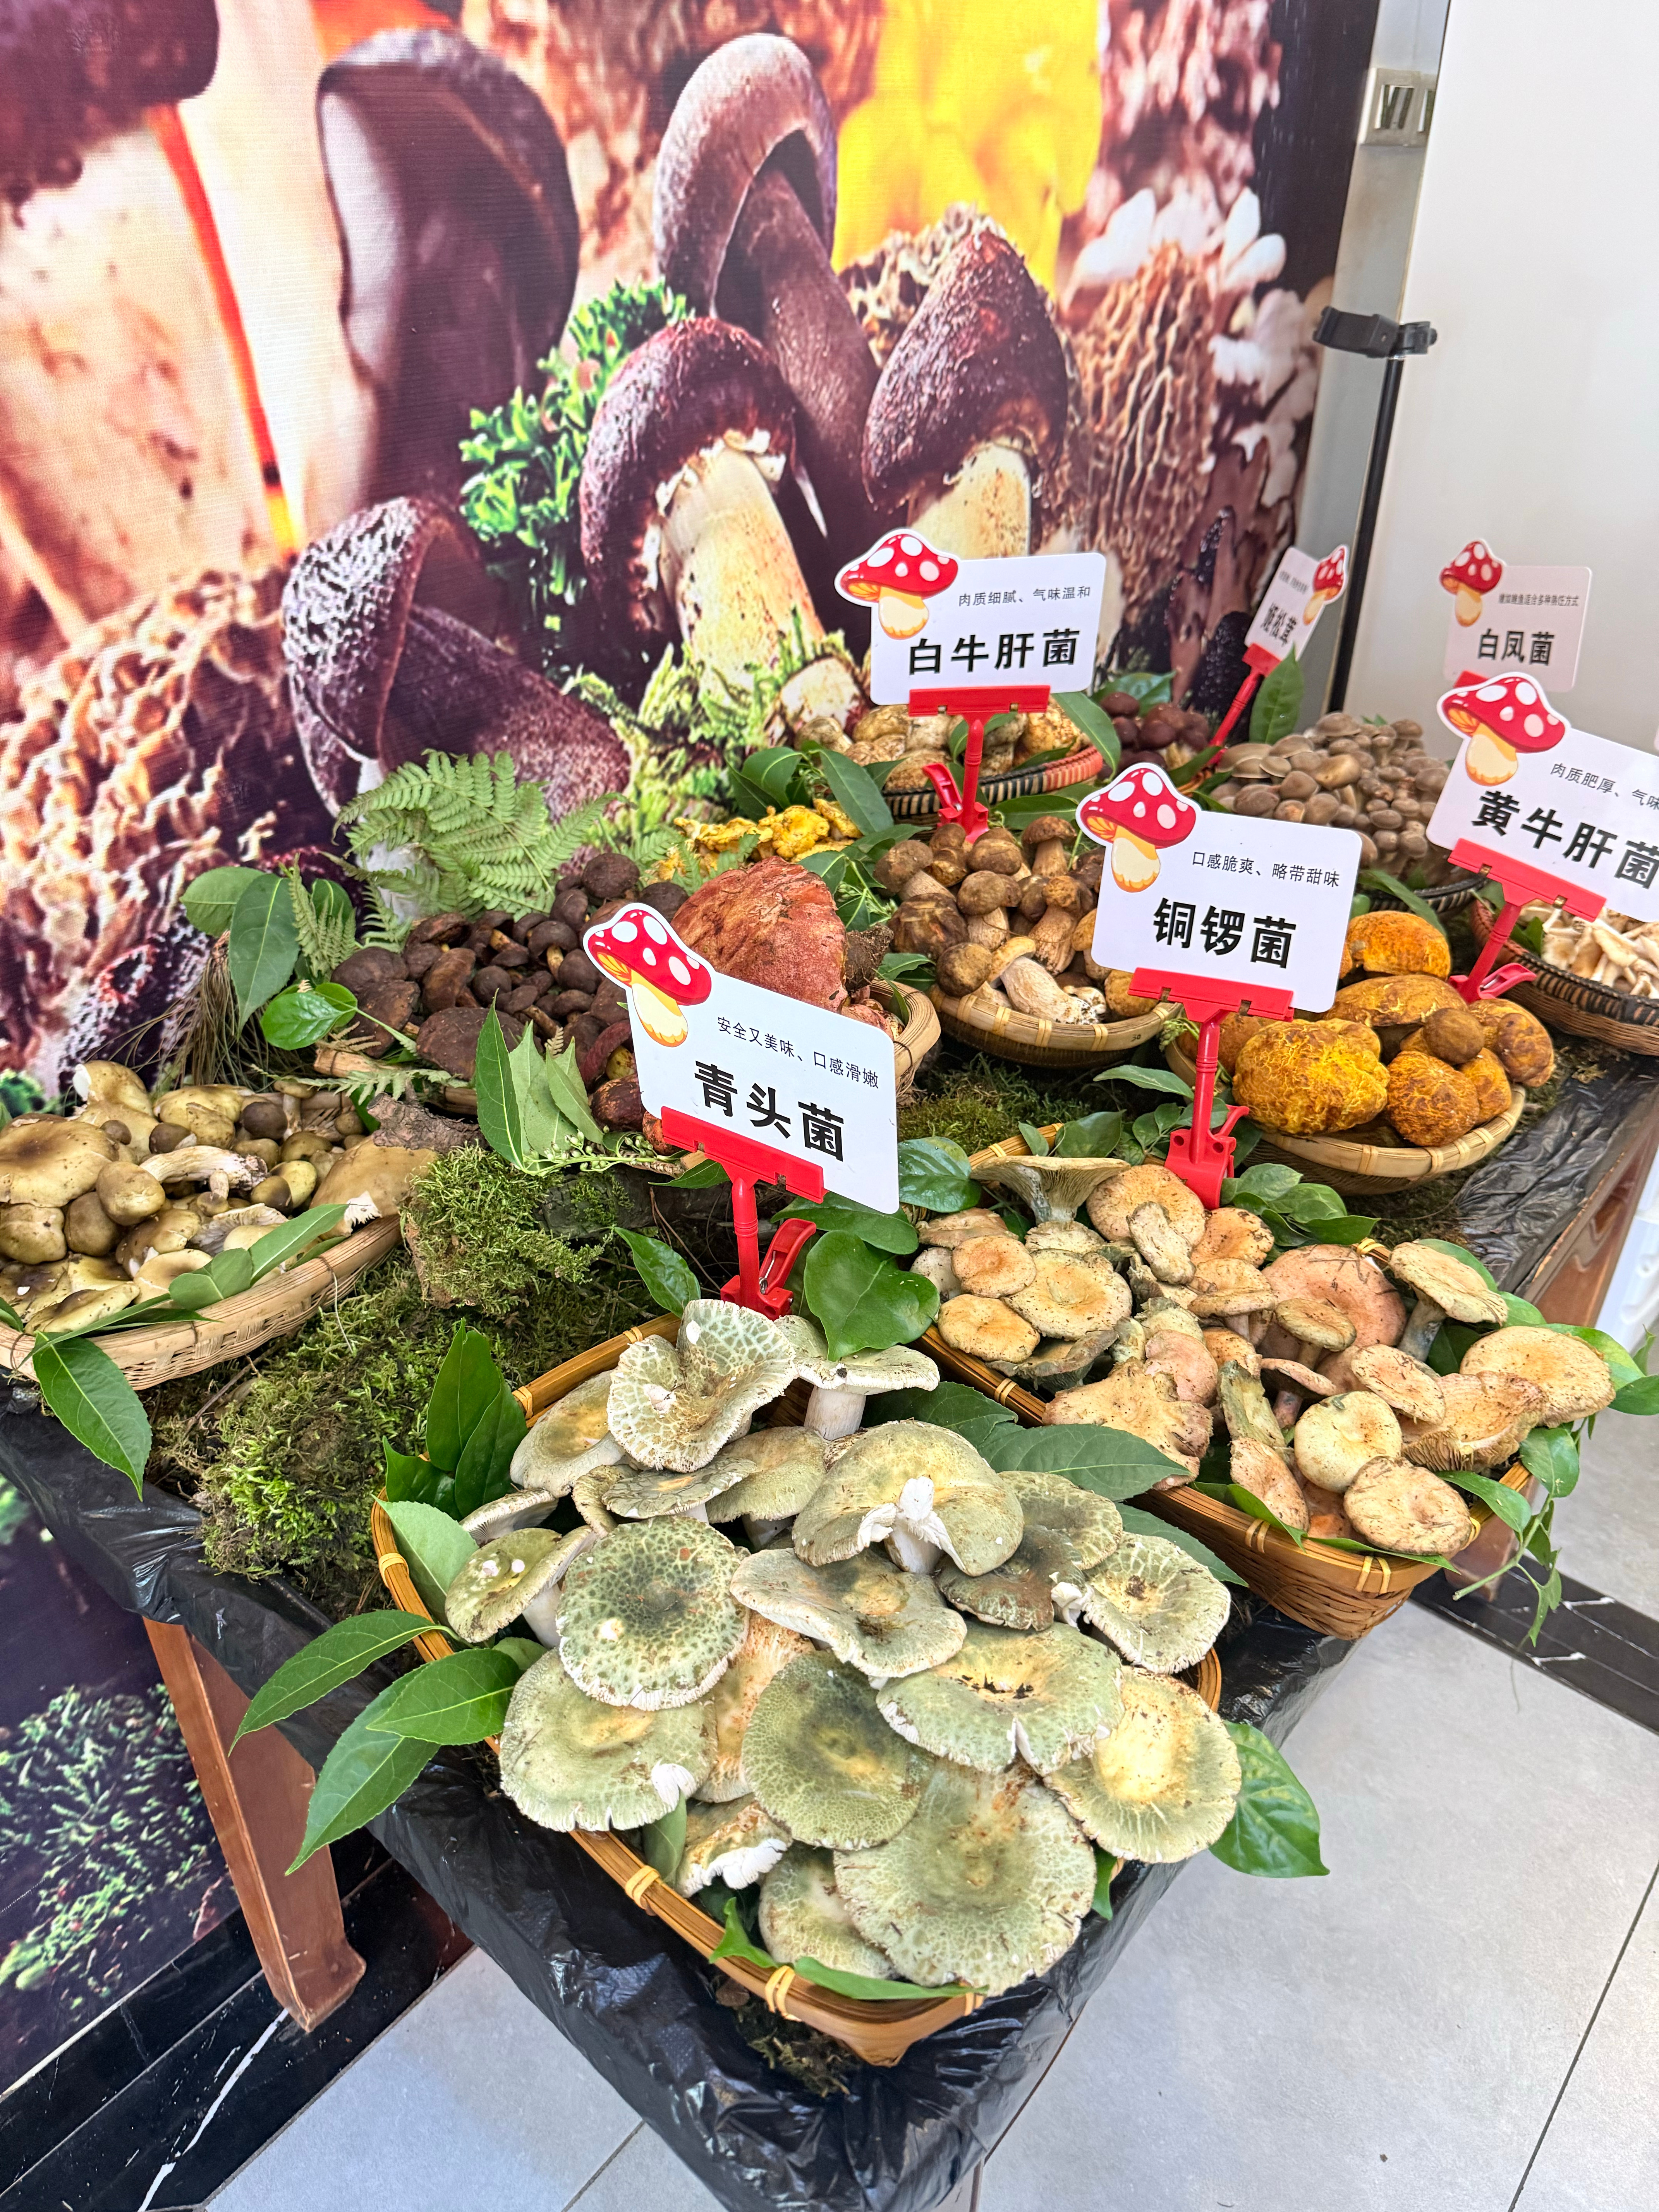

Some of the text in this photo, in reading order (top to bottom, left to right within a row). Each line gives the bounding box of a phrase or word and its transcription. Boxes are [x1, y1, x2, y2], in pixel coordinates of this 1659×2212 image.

[959, 586, 1090, 606] 肉质细腻、气味温和
[910, 629, 1080, 675] 白牛肝菌
[1477, 628, 1554, 666] 白凤菌
[1550, 763, 1659, 809] 肉质肥厚、气味
[1472, 791, 1659, 889] 黄牛肝菌
[1193, 852, 1339, 887] 口感脆爽、略带甜味
[1153, 898, 1296, 969] 铜锣菌
[718, 1017, 878, 1089] 安全又美味、口感滑嫩
[694, 1061, 844, 1162] 青头菌
